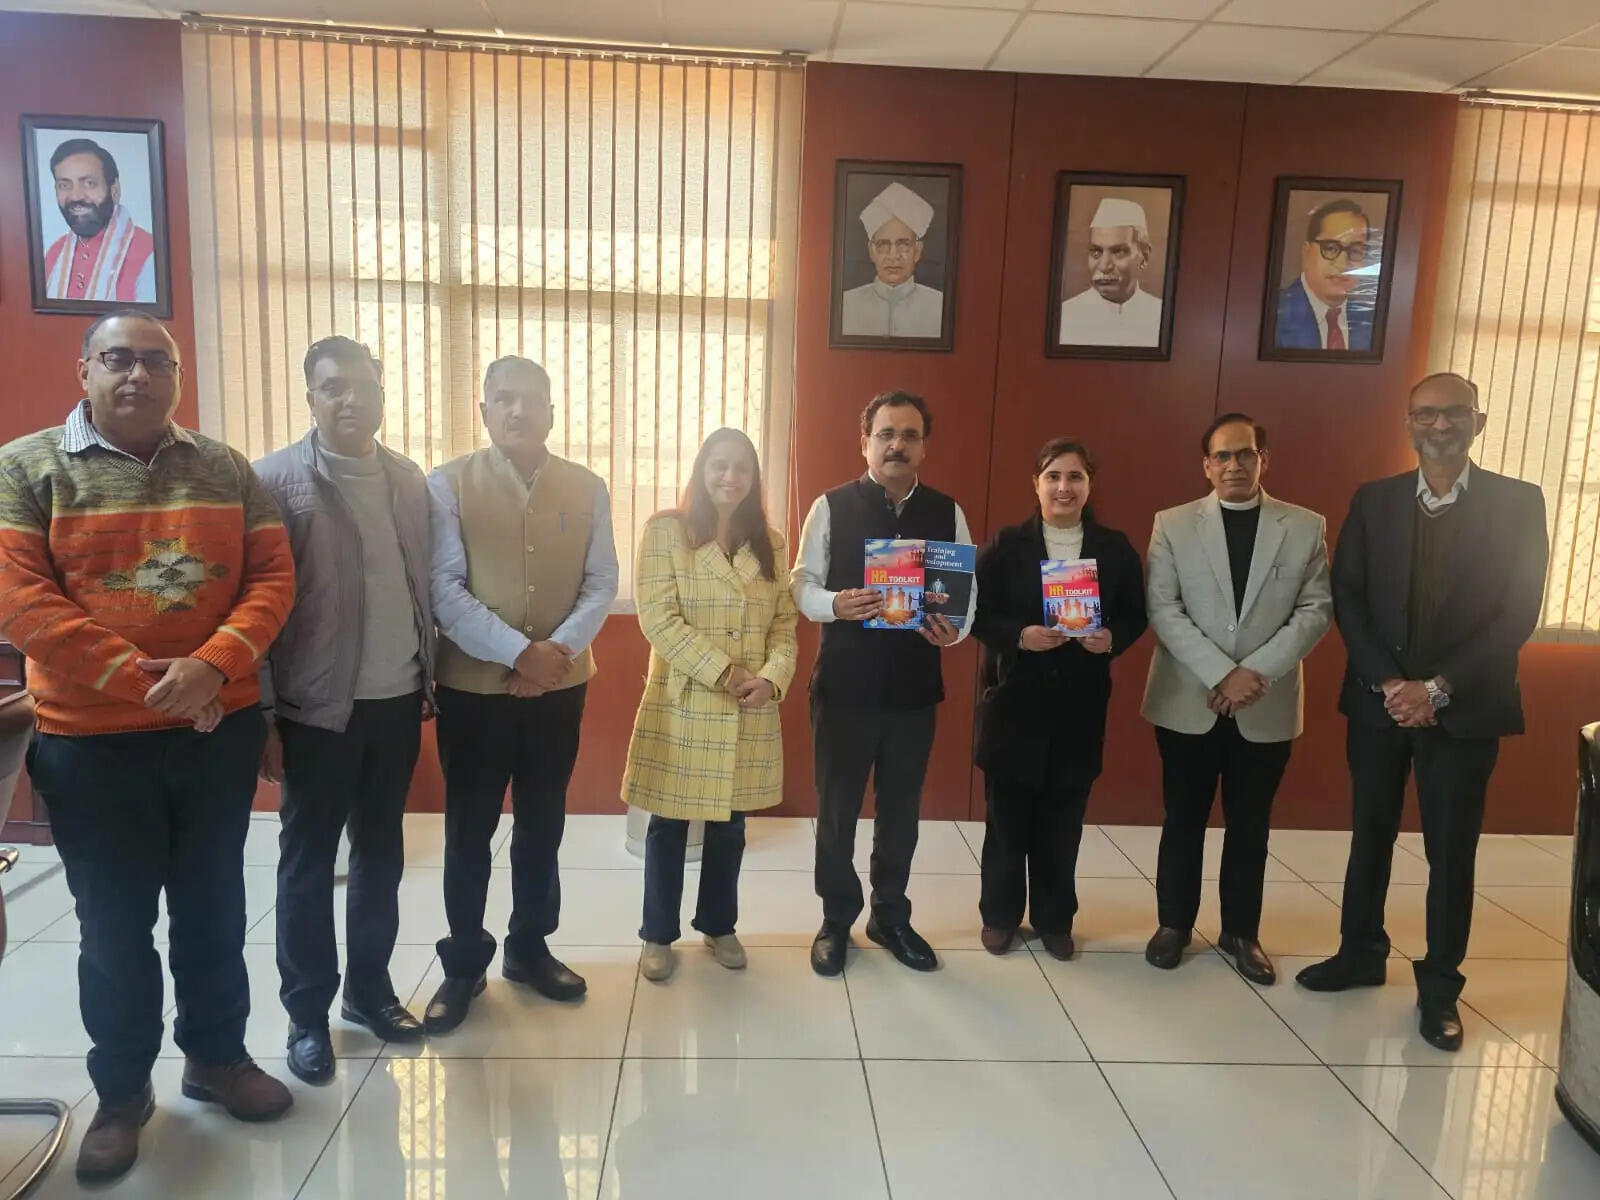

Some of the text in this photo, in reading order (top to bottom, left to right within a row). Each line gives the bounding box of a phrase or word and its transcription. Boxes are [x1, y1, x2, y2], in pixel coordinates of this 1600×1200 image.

[927, 547, 957, 556] Training
[925, 559, 962, 568] velopment
[871, 569, 887, 583] HR
[1049, 585, 1064, 596] HR
